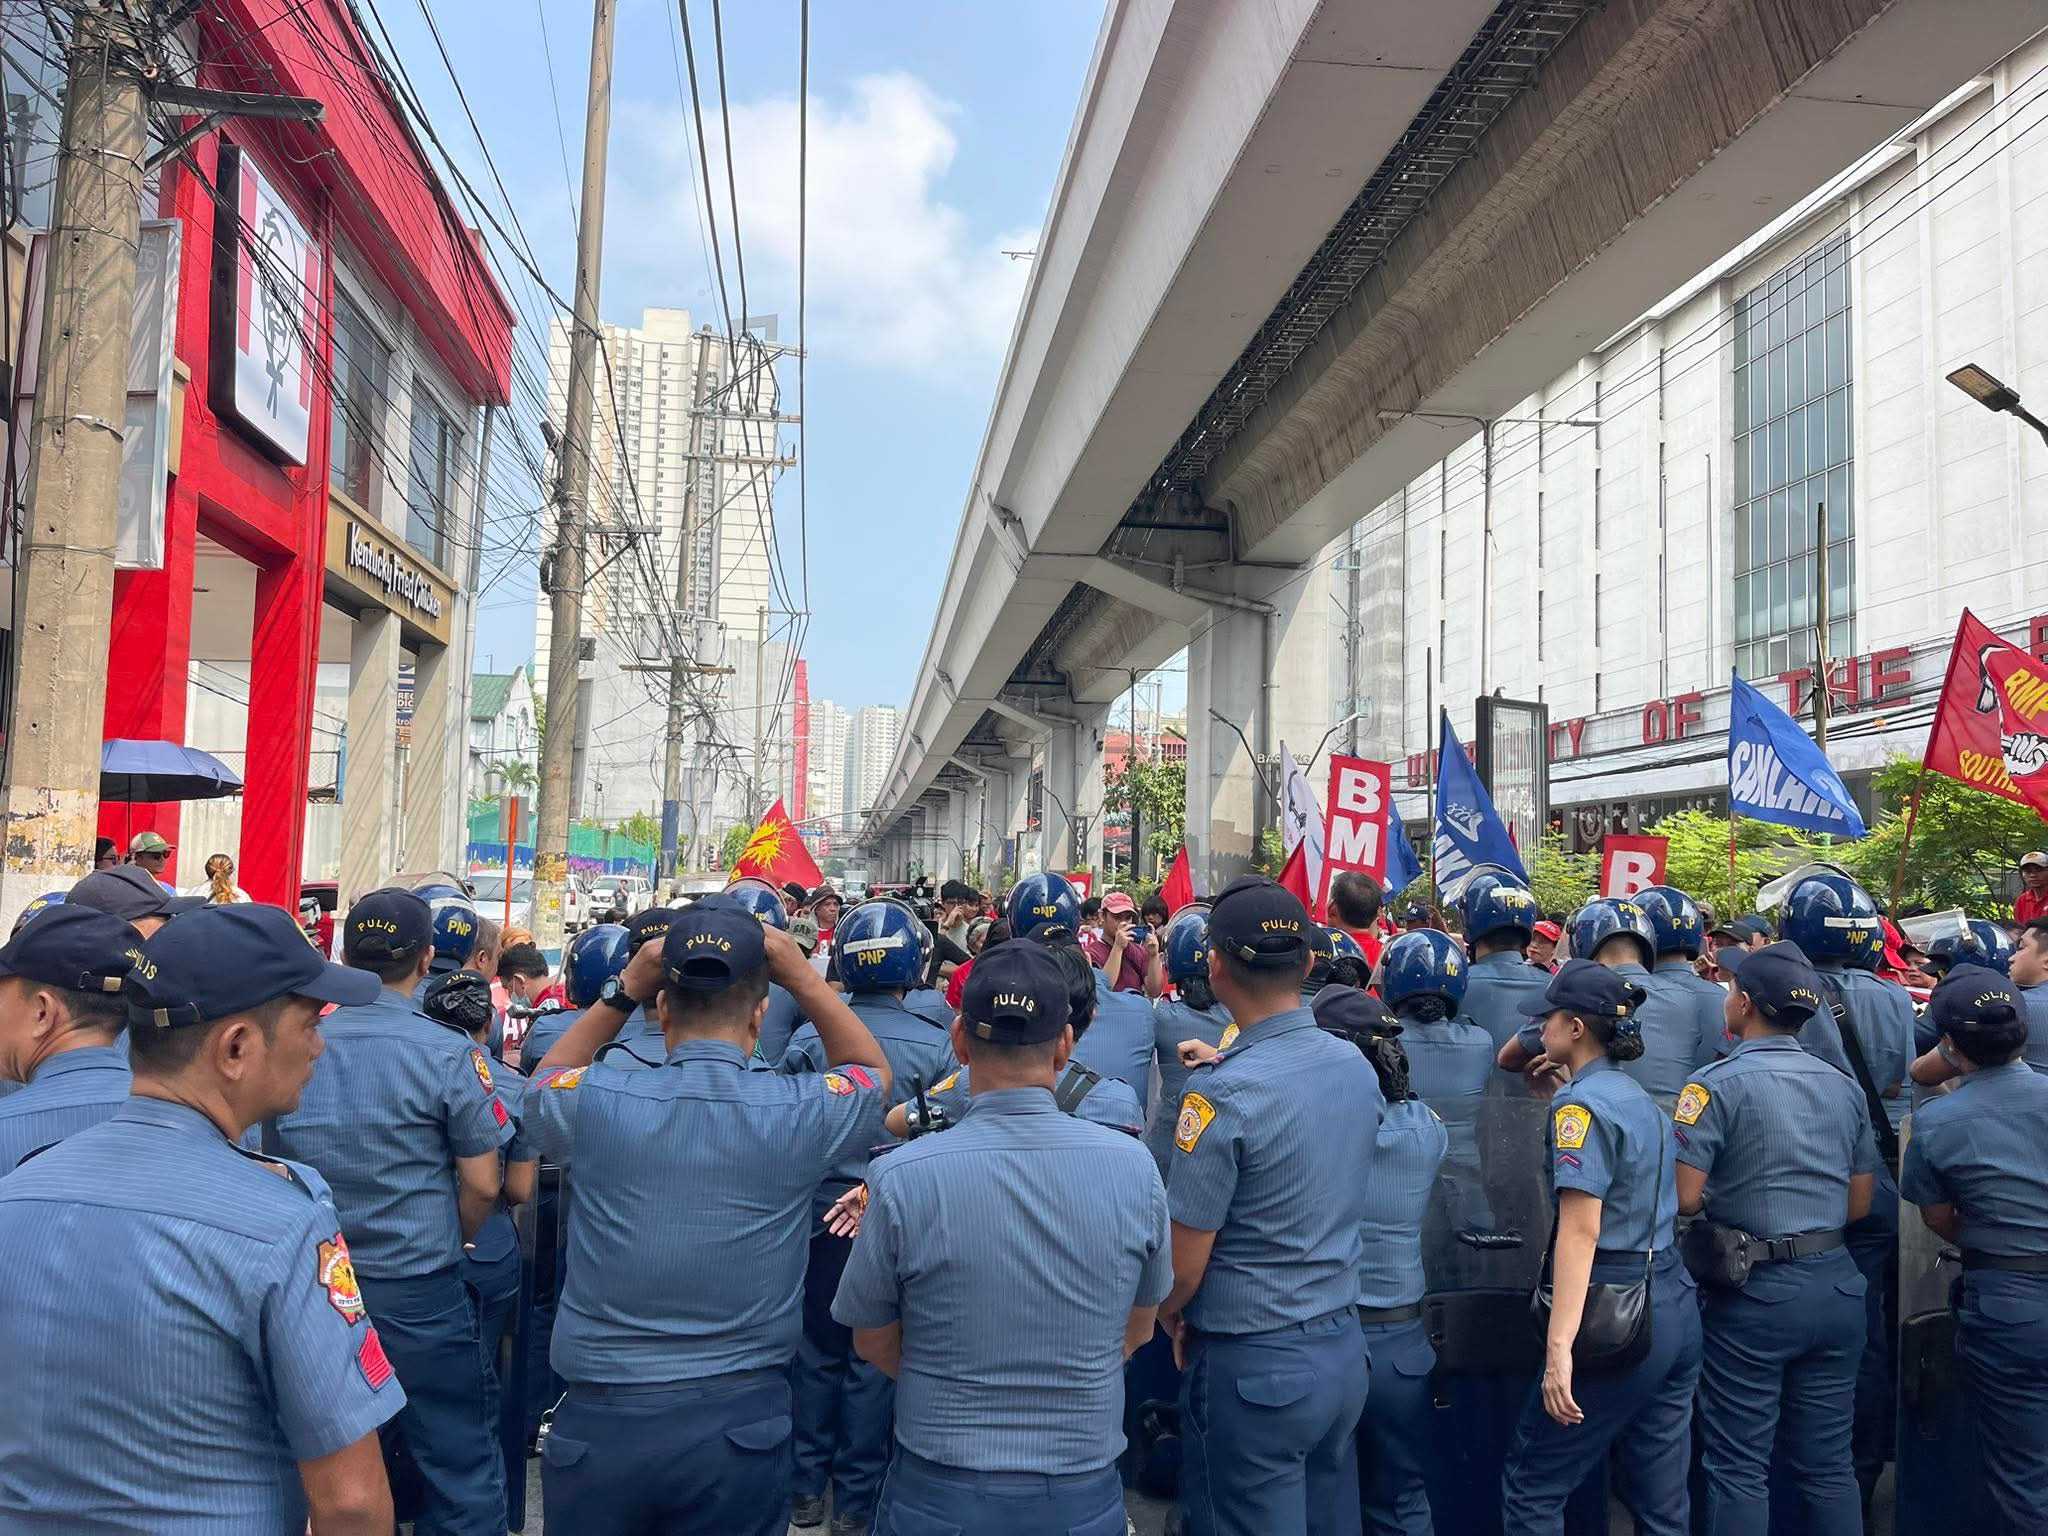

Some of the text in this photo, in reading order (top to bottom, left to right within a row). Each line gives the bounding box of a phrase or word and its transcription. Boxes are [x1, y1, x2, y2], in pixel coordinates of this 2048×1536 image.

[348, 521, 393, 593] Kentucky
[1642, 647, 1912, 744] OF THE
[358, 919, 398, 934] PULIS
[447, 919, 473, 937] PNP
[640, 924, 670, 935] PULIS
[1261, 919, 1300, 933] PULIS
[685, 933, 732, 953] PULIS
[857, 949, 887, 967] PNP
[994, 993, 1035, 1013] PULIS
[1974, 991, 2011, 1008] PULIS
